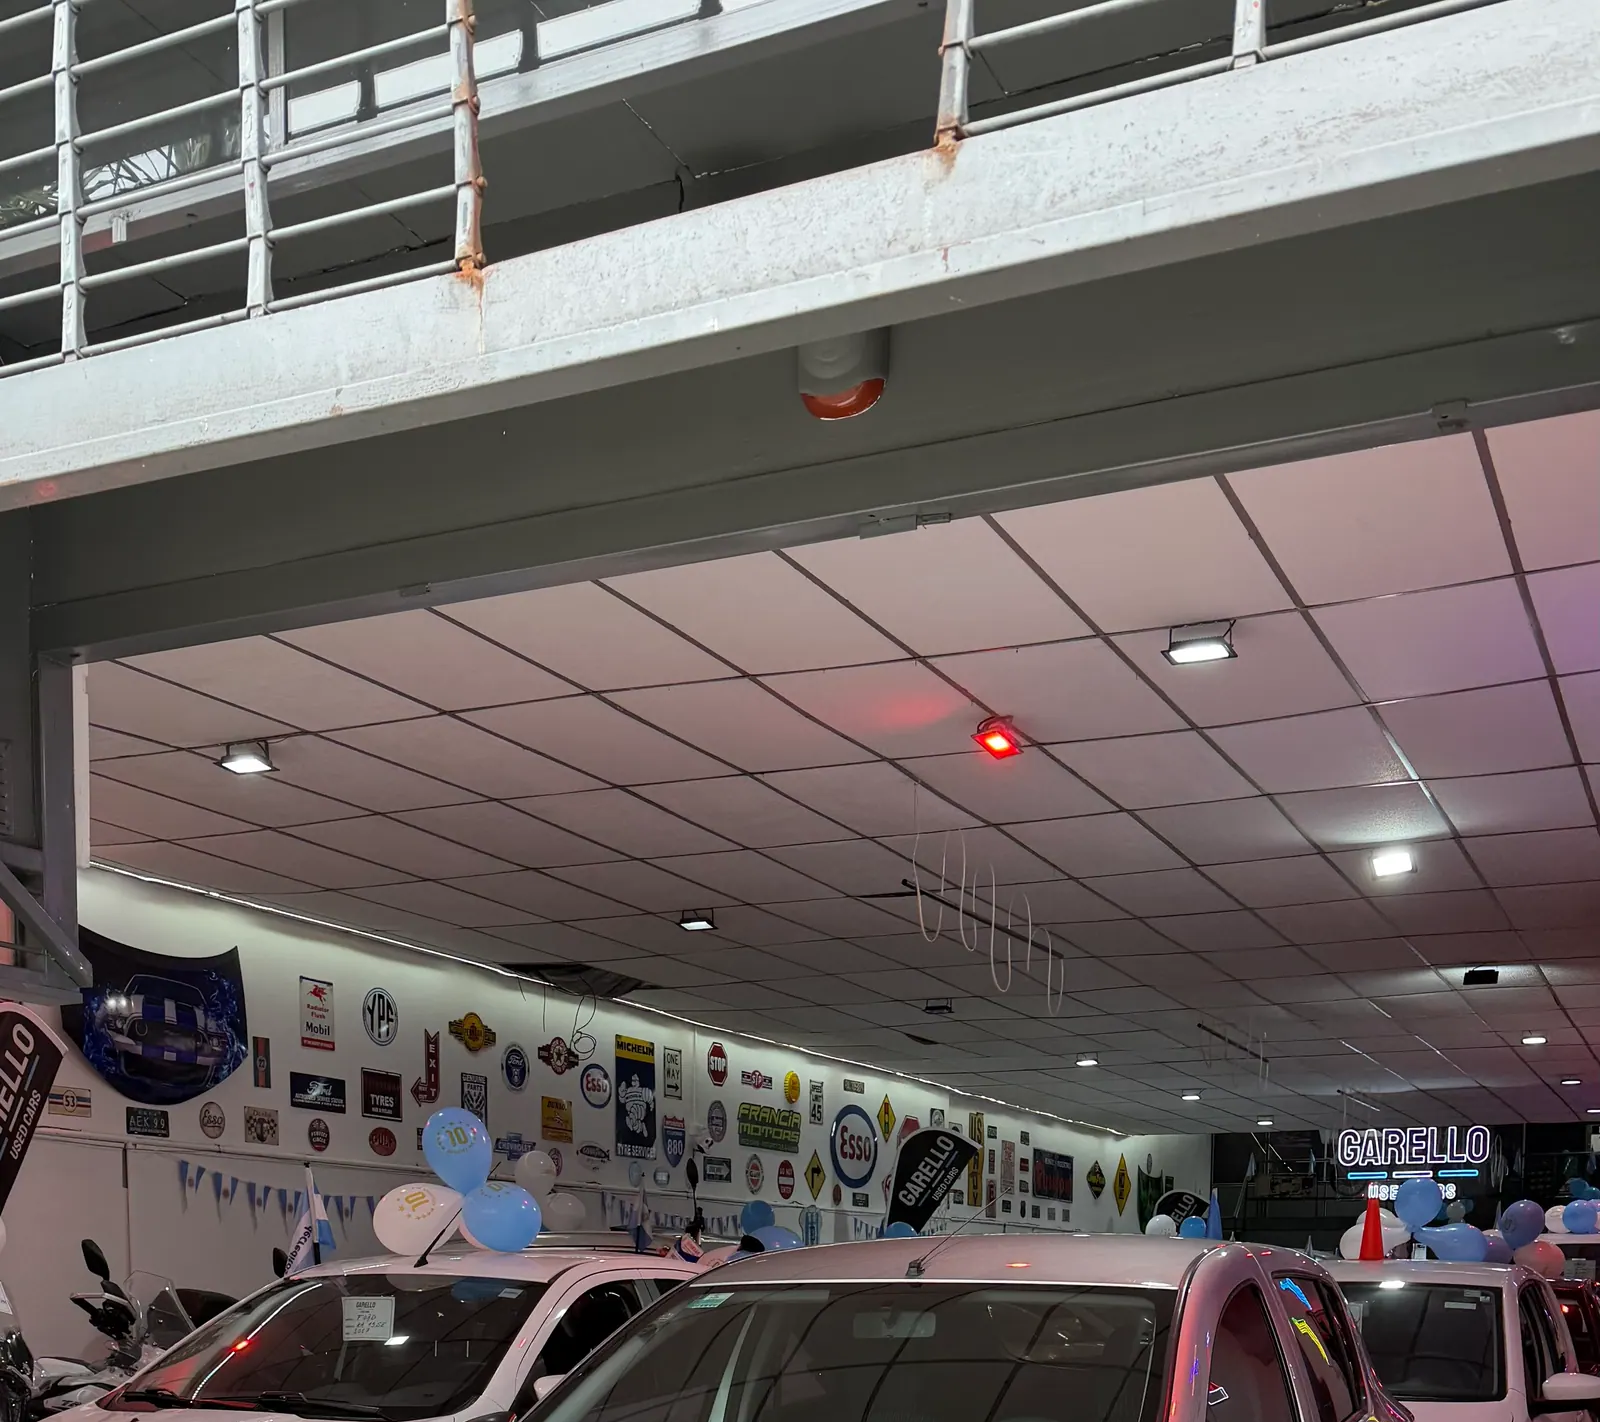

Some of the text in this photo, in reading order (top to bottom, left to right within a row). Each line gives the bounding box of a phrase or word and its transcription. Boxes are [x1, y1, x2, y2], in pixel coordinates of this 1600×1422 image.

[366, 993, 394, 1039] YPF
[305, 1021, 330, 1036] Mobil
[616, 1041, 655, 1057] MICHELIN
[508, 1054, 524, 1067] Ford
[666, 1052, 679, 1066] ONE
[710, 1056, 726, 1072] STOP
[428, 1043, 437, 1097] EXIT
[666, 1068, 680, 1080] WAY
[0, 1023, 35, 1134] ELLO
[466, 1083, 483, 1092] PARTS
[65, 1094, 76, 1107] 53
[370, 1093, 394, 1107] TYRES
[811, 1103, 822, 1121] 45
[9, 1089, 42, 1160] USED CARS
[129, 1116, 150, 1128] AEK
[445, 1127, 468, 1147] 10
[739, 1122, 800, 1143] MOTORS
[498, 1141, 532, 1151] CHEVROLET
[617, 1143, 632, 1157] TYRE
[667, 1138, 683, 1156] 880
[1337, 1125, 1491, 1167] GARELLO
[898, 1134, 955, 1207] GARELLO
[780, 1186, 792, 1194] ENTER
[931, 1183, 948, 1202] USED
[944, 1166, 959, 1186] CARS
[1367, 1182, 1399, 1201] USE
